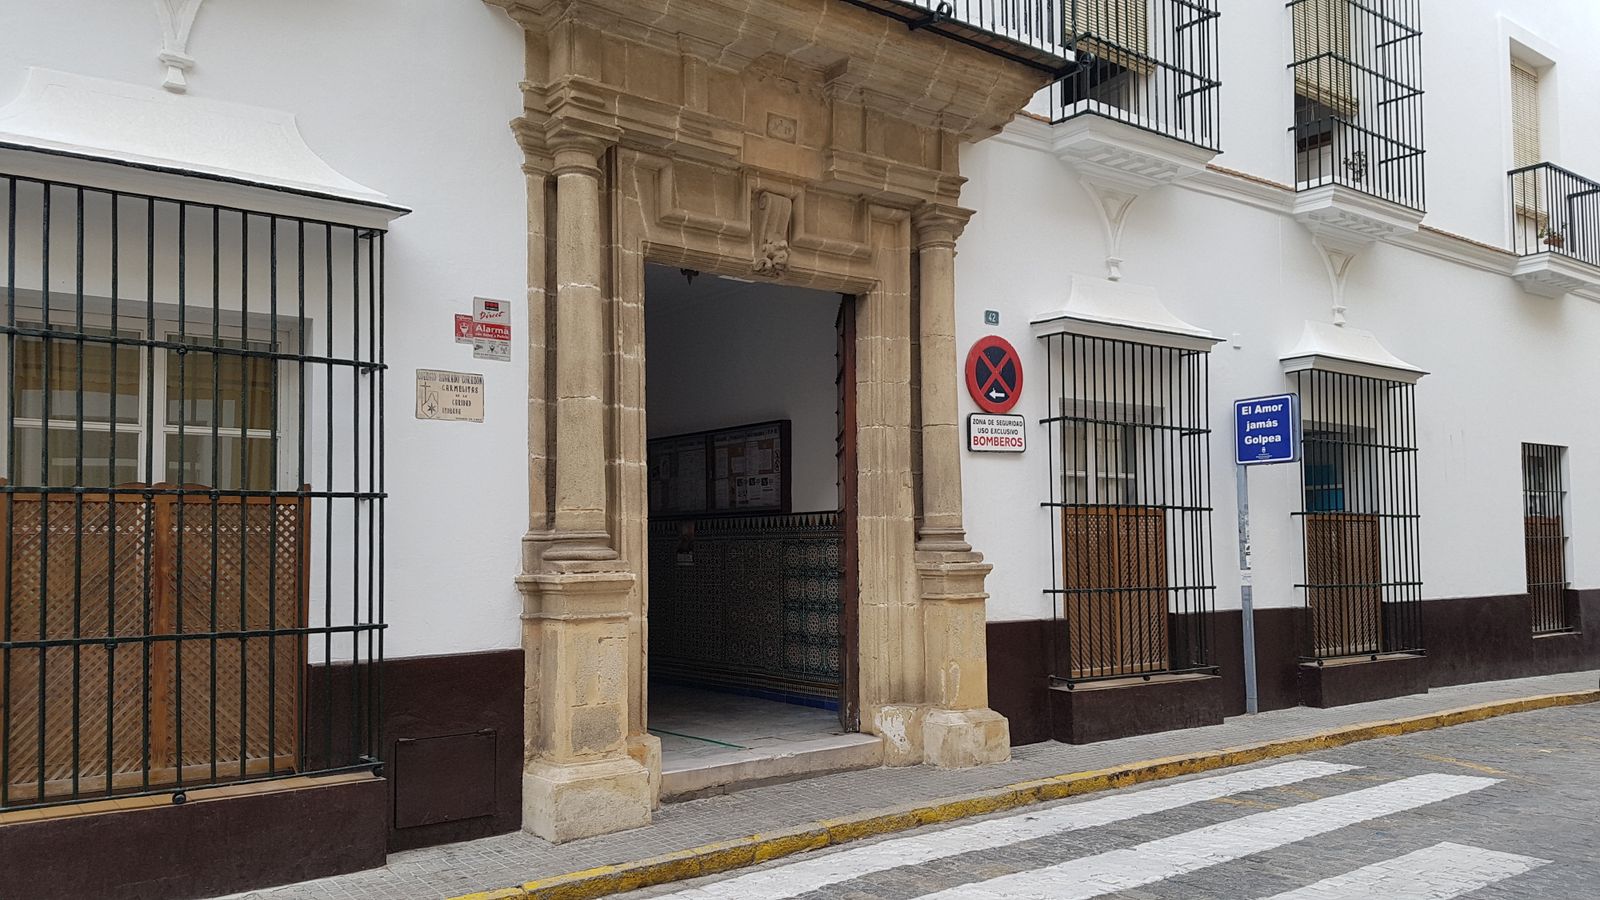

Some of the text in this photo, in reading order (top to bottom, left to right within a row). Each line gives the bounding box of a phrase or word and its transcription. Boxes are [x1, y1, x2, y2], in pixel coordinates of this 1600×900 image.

[988, 312, 996, 323] 42
[475, 325, 509, 335] Alarma
[441, 384, 479, 394] CARMELITAS
[1241, 404, 1283, 416] El Amor
[996, 419, 1023, 427] SEGURIDAD
[1245, 418, 1279, 432] jamás
[973, 436, 1023, 447] BOMBEROS
[1244, 434, 1282, 445] Golpea
